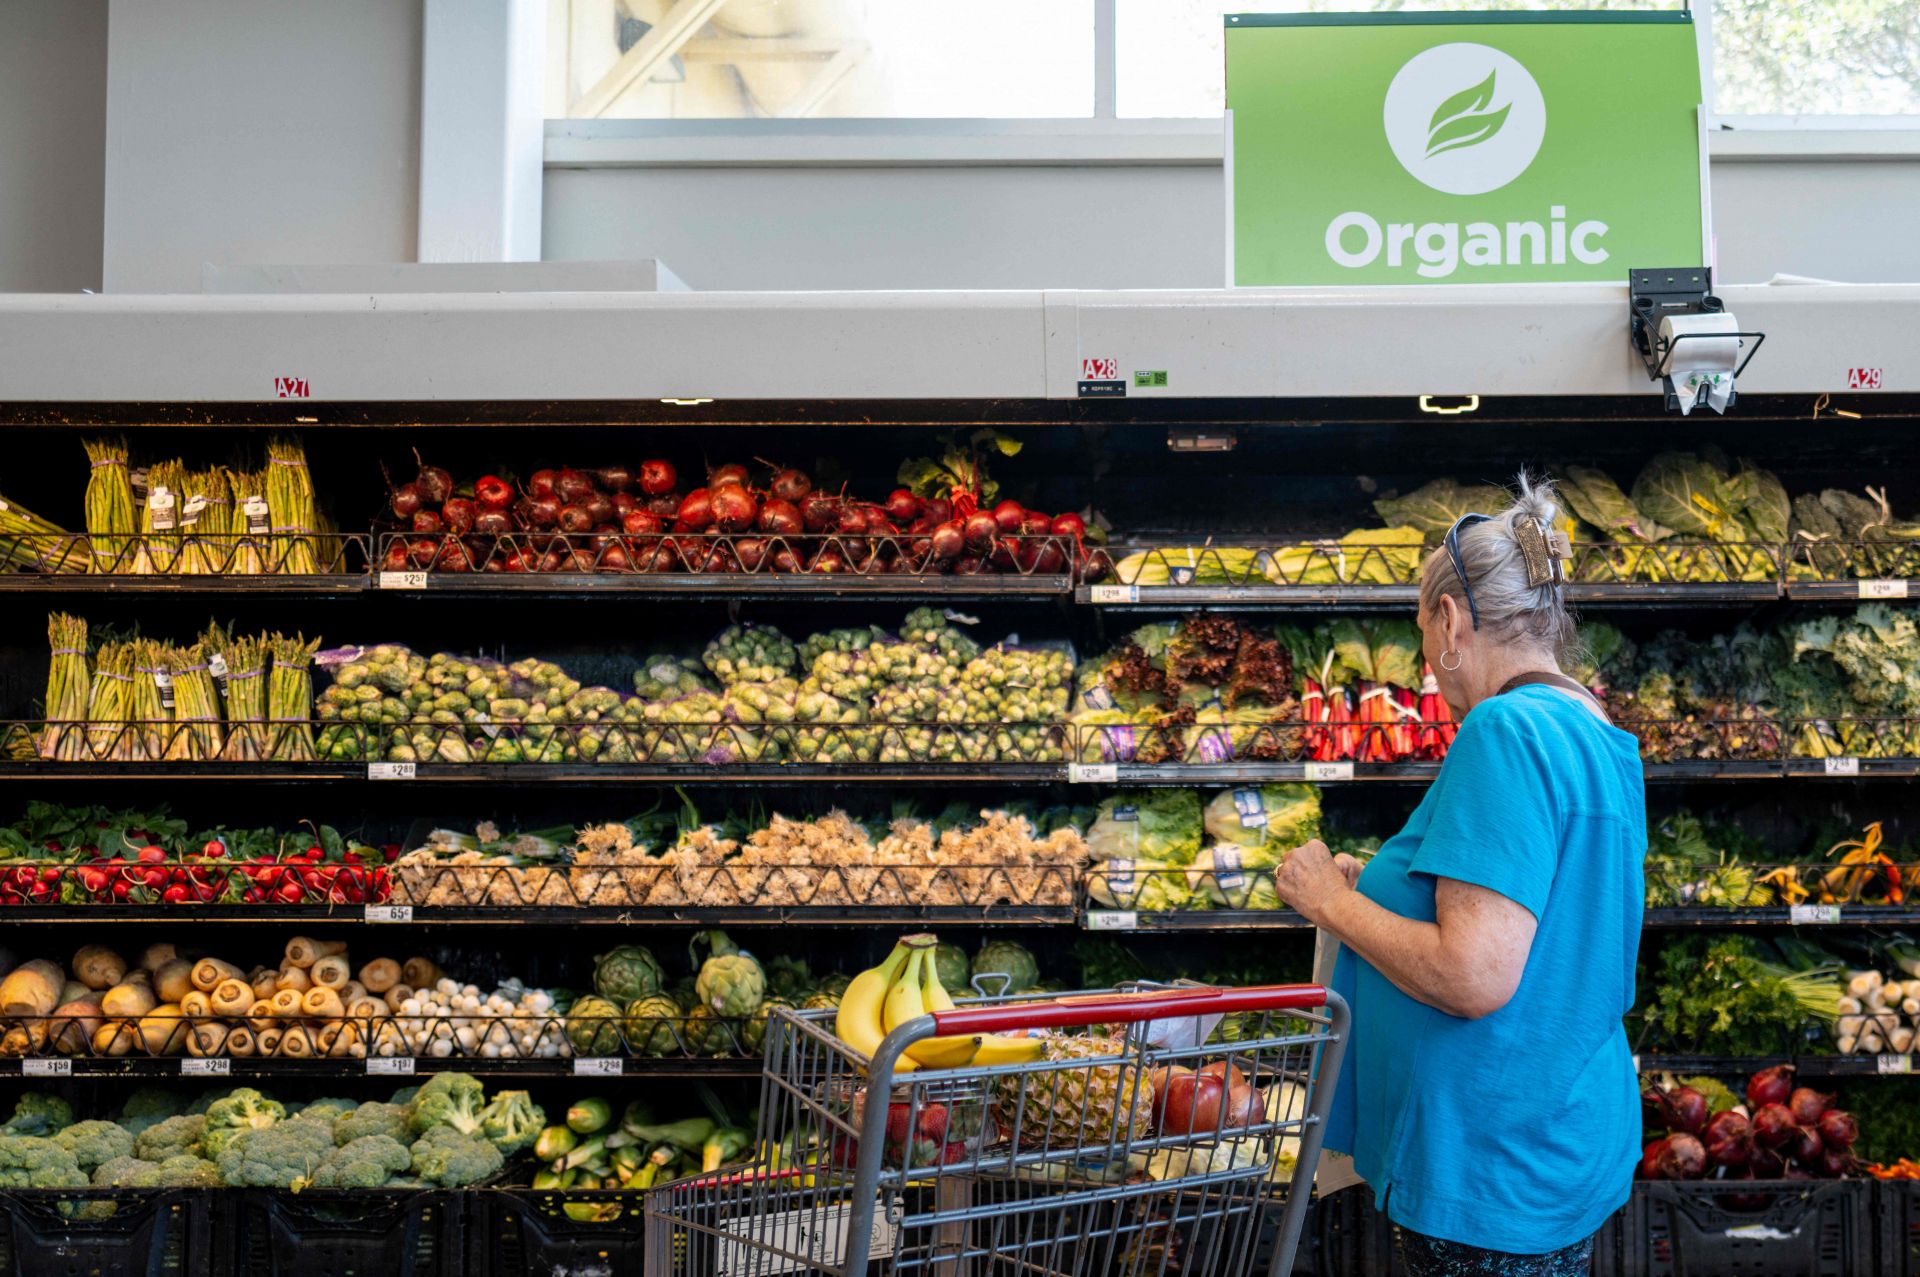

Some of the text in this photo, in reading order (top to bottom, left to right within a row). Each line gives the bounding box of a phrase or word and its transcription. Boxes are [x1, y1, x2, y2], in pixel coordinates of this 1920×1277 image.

[1325, 205, 1611, 278] Organic
[1083, 359, 1117, 379] A28
[1848, 368, 1882, 389] A29
[275, 377, 309, 397] A27
[205, 1060, 228, 1072] $298
